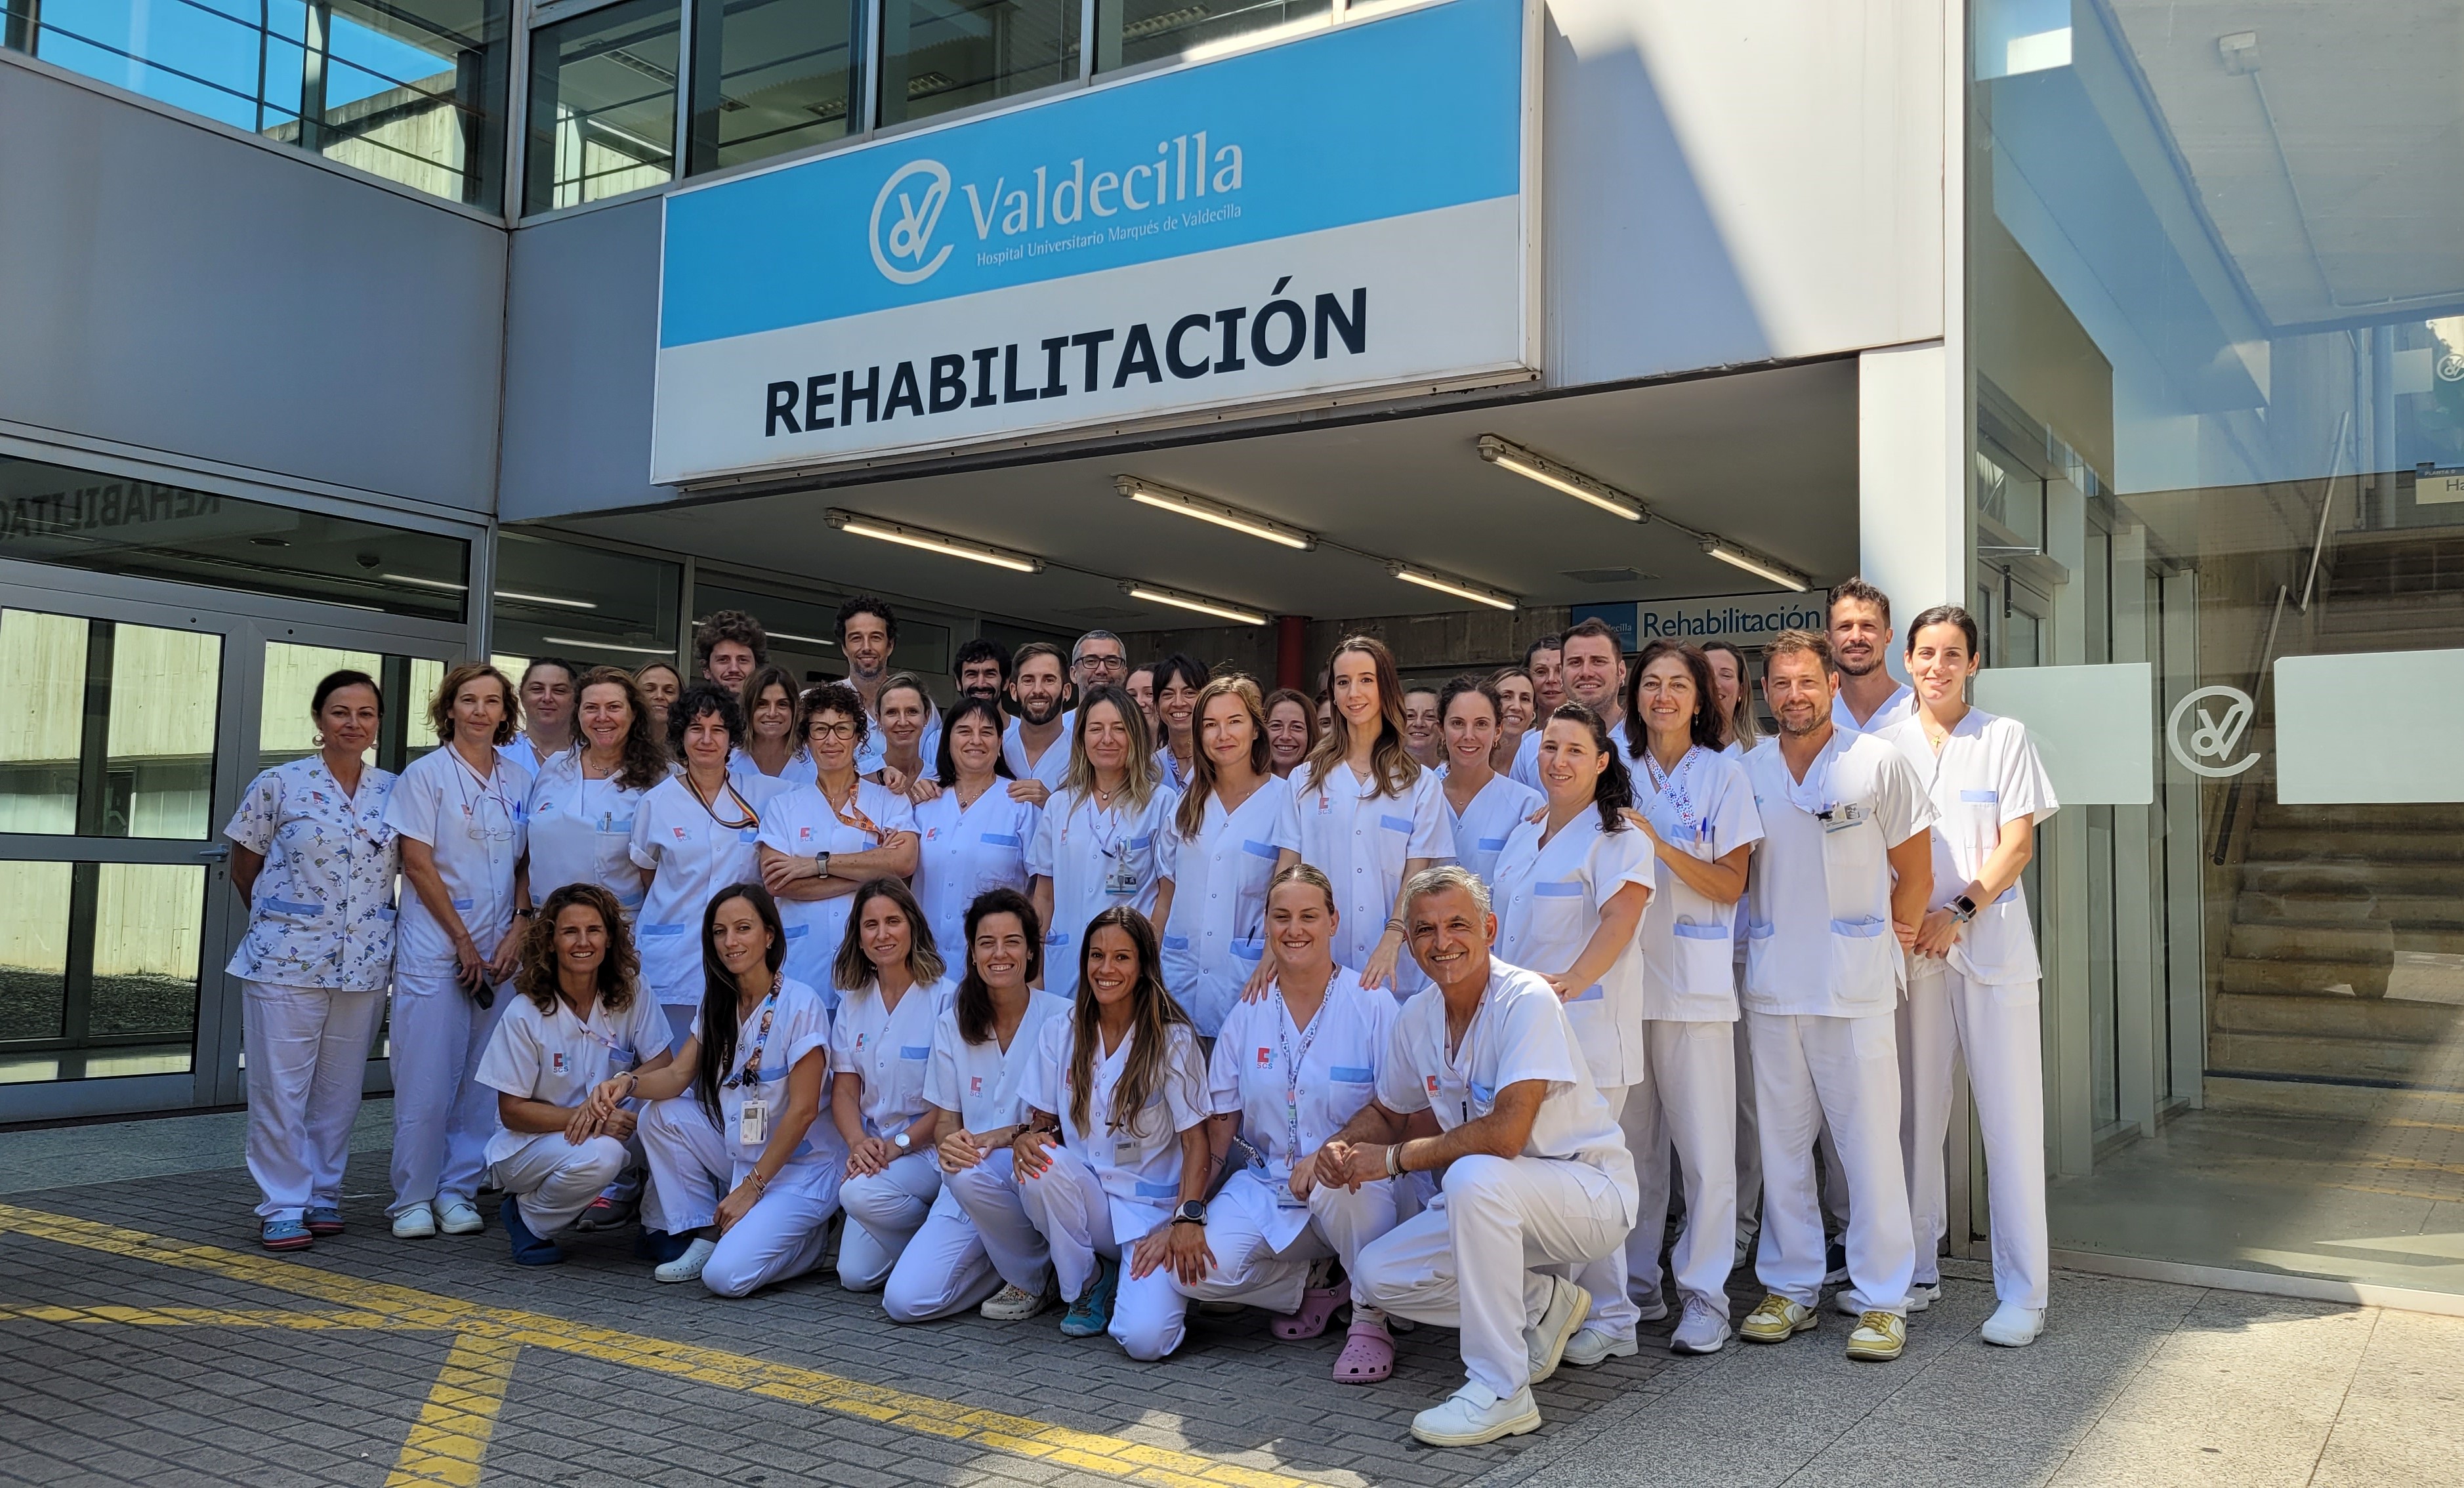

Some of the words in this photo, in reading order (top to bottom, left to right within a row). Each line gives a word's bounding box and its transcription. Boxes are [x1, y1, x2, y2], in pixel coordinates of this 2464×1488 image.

[961, 130, 1243, 241] Valdecilla
[976, 245, 1024, 267] Hospital
[1028, 230, 1104, 258] Universitario
[1108, 222, 1159, 242] Marqués
[1163, 217, 1178, 231] de
[1182, 203, 1241, 228] Valdecilla
[764, 276, 1368, 438] REHABILITACIÓN
[1643, 604, 1820, 638] Rehabilitación
